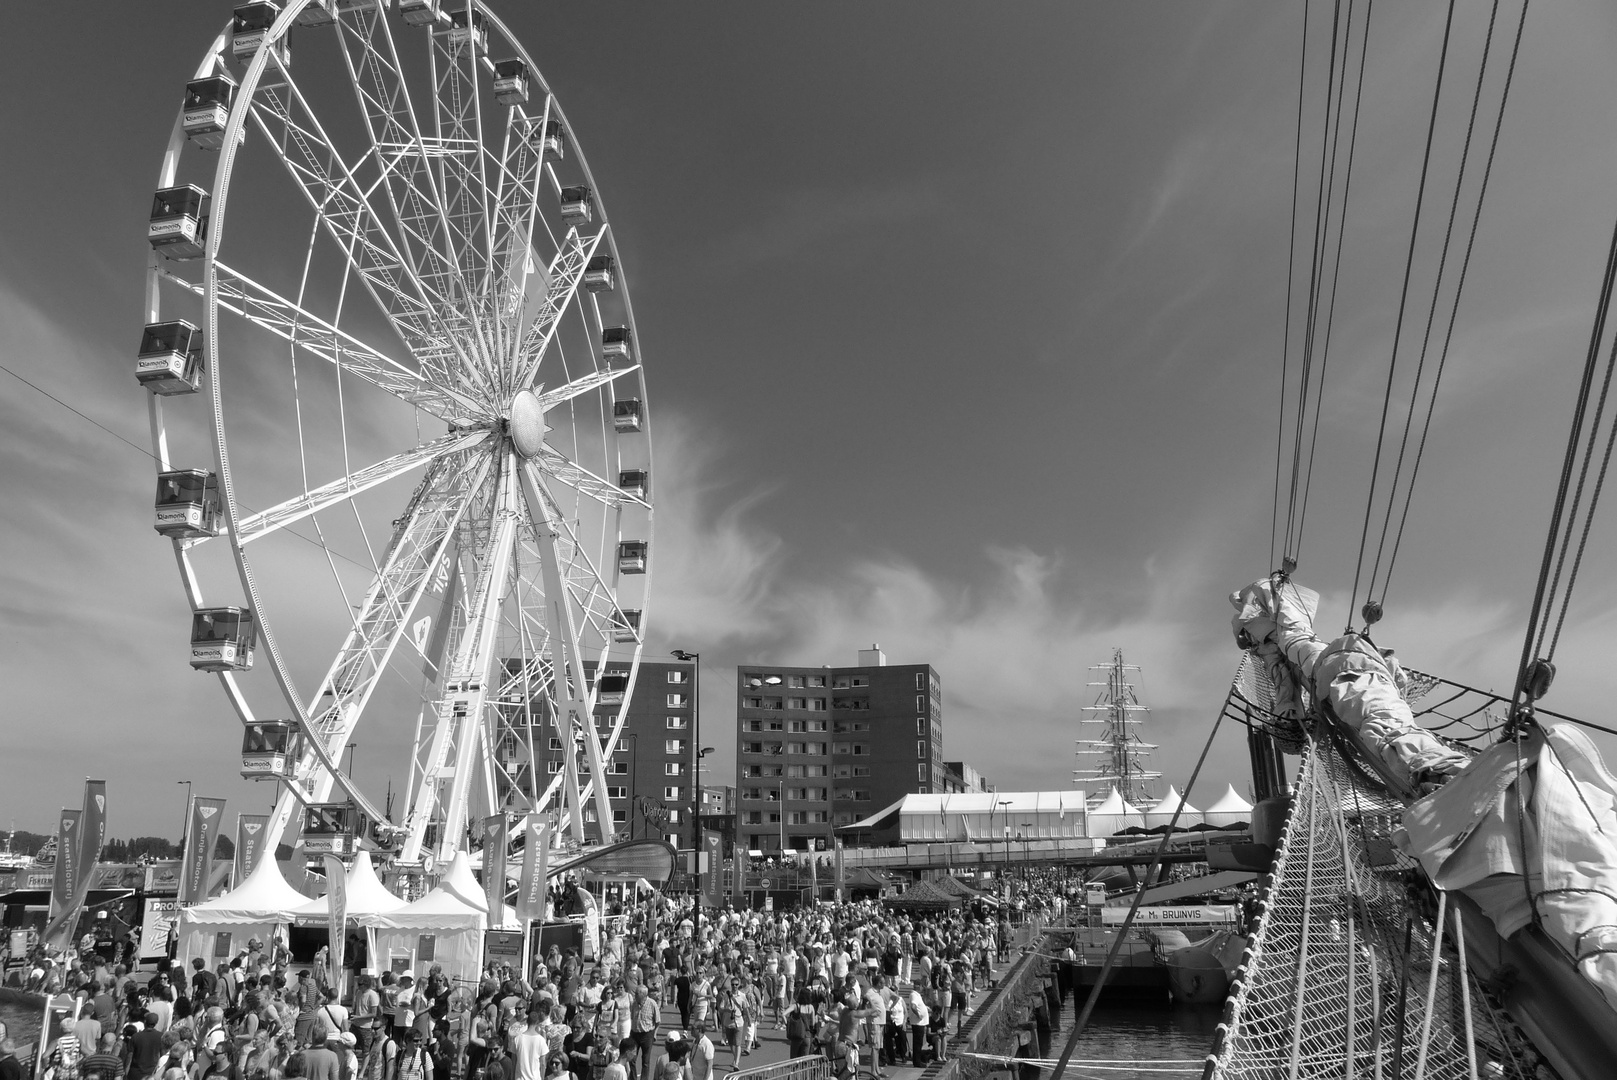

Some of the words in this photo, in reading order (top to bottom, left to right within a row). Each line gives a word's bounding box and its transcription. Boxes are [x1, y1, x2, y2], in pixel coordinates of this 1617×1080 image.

[157, 511, 187, 521] Diamond
[198, 823, 208, 853] Oranje
[193, 855, 203, 891] Peloton
[1162, 909, 1202, 919] BRUINVIS
